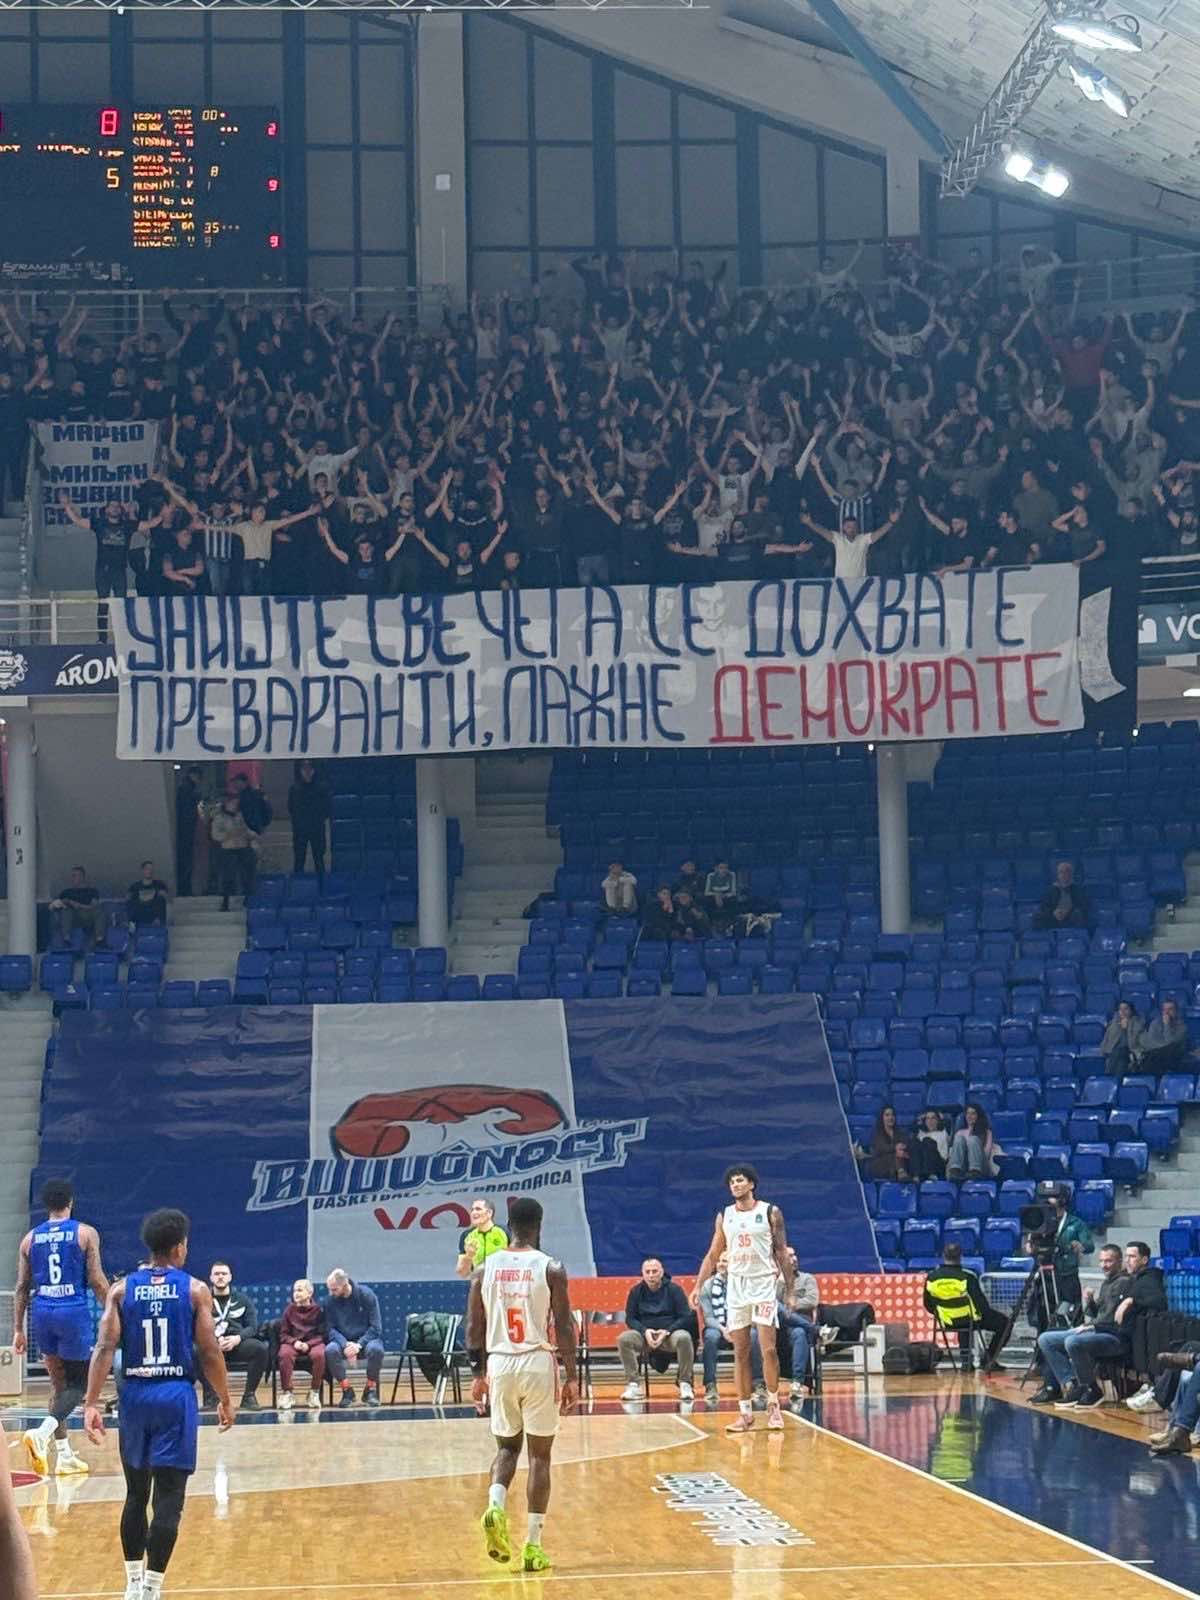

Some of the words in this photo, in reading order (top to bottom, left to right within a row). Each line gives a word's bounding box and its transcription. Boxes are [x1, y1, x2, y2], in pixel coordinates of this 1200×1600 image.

[106, 167, 120, 188] 5
[366, 591, 471, 667] СВЕ
[648, 582, 717, 657] СЕ
[745, 566, 1031, 658] ДОХВАТЕ
[130, 669, 494, 754] ПРЕВАРАНТИ,
[504, 662, 686, 746] ЛАЖНЕ
[709, 652, 1062, 743] ДЕМОКРАТЕ
[48, 1253, 62, 1285] 6
[134, 1284, 179, 1301] FERRELL
[142, 1317, 171, 1365] 11
[507, 1308, 525, 1344] 5
